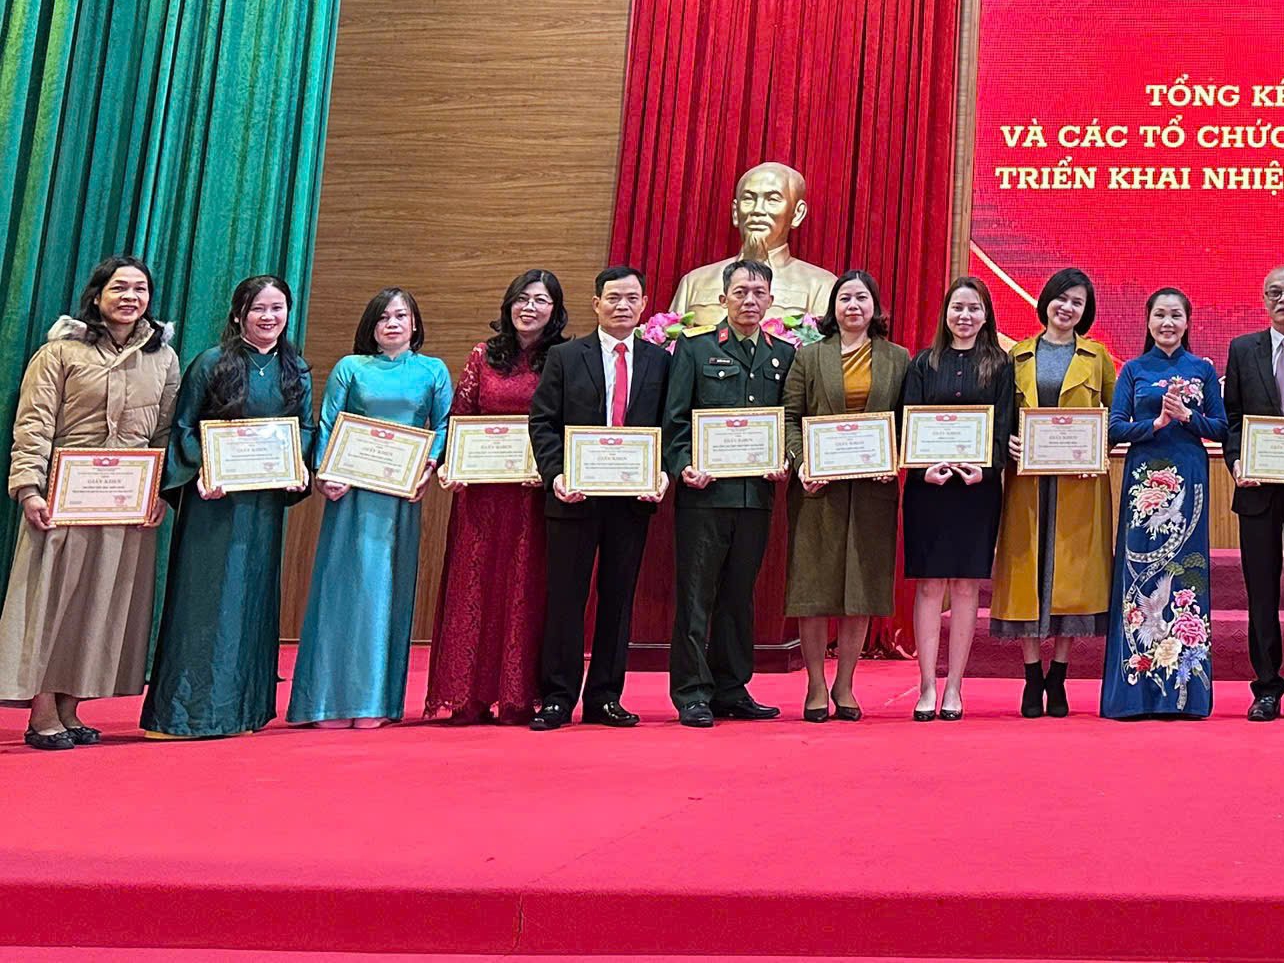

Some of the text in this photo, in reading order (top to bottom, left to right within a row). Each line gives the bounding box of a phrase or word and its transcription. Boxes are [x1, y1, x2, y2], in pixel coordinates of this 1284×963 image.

[1146, 74, 1241, 107] TỔNG
[1000, 118, 1048, 148] VÀ
[1058, 118, 1129, 149] CÁC
[1140, 115, 1186, 149] TỔ
[995, 156, 1098, 190] TRIỂN
[1108, 168, 1192, 191] KHAI
